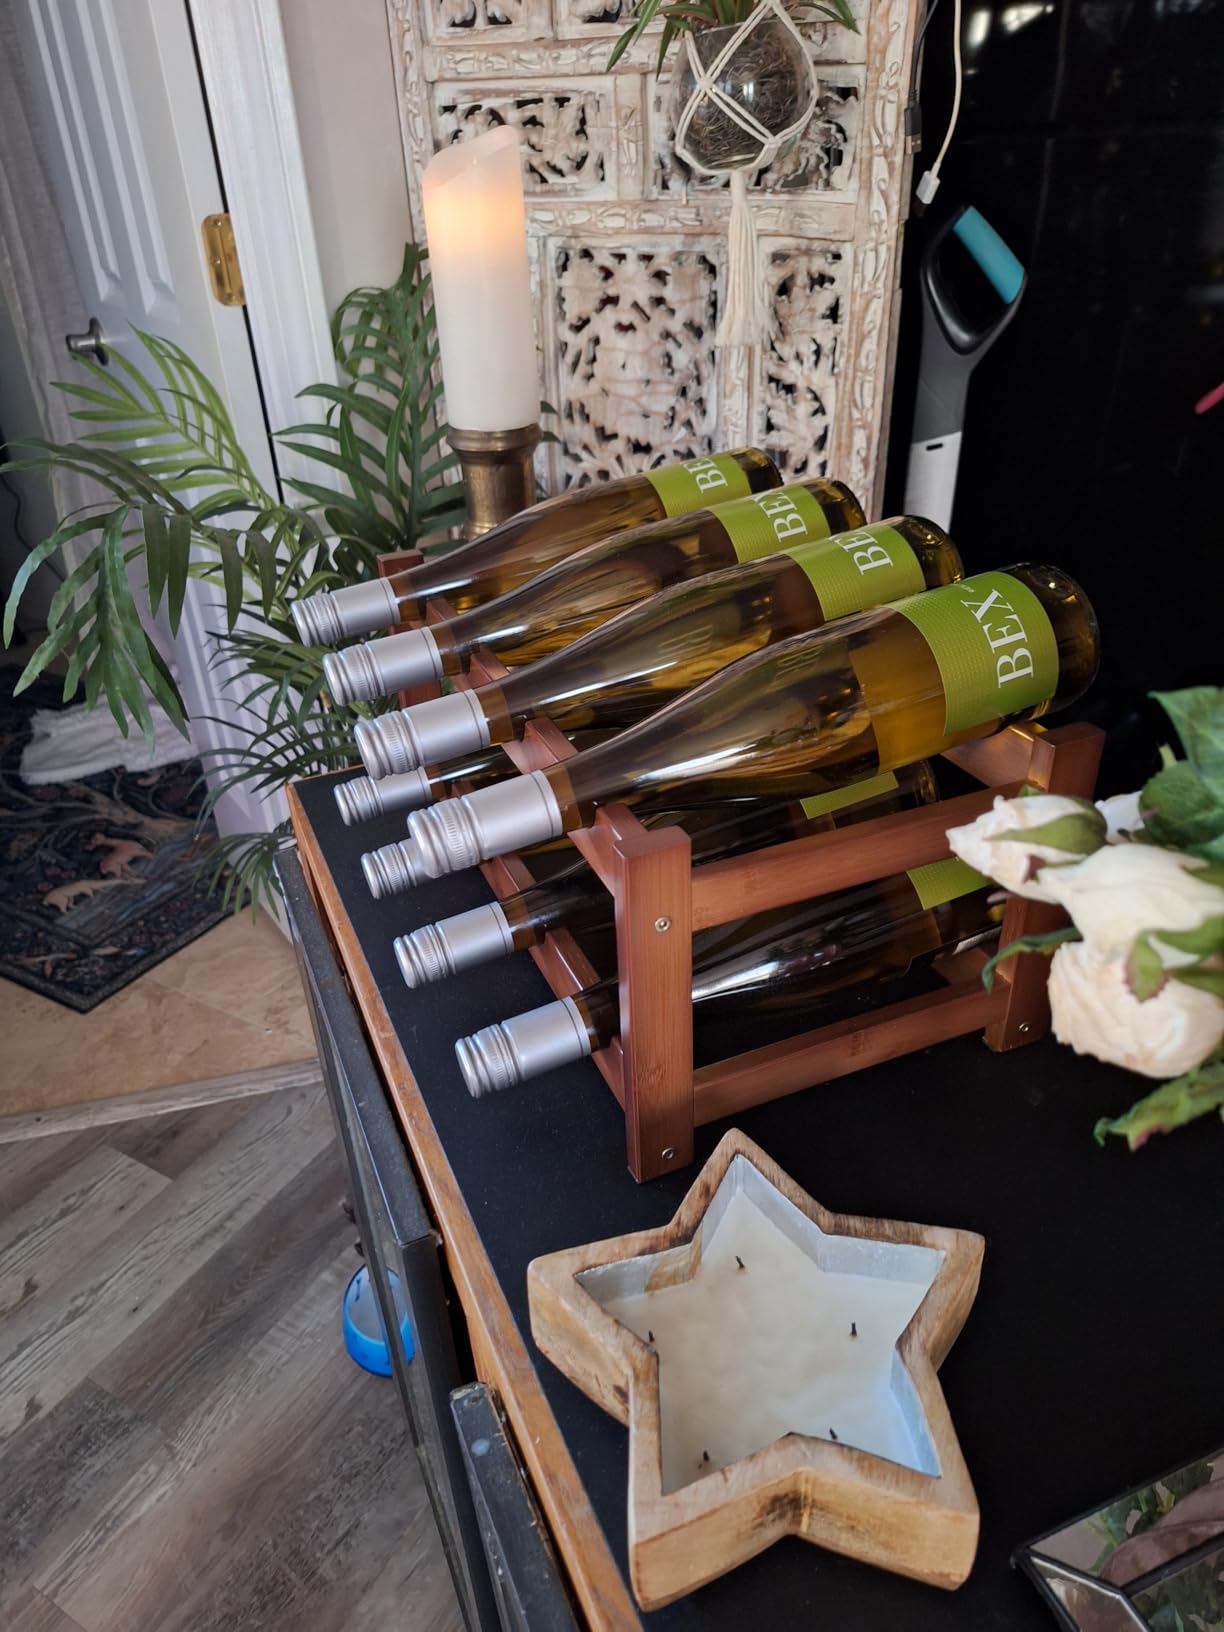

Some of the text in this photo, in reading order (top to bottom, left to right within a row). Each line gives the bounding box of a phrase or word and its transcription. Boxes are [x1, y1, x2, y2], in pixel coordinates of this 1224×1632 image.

[683, 457, 729, 494] BE
[830, 531, 894, 576] BE
[960, 588, 1034, 689] BEX
